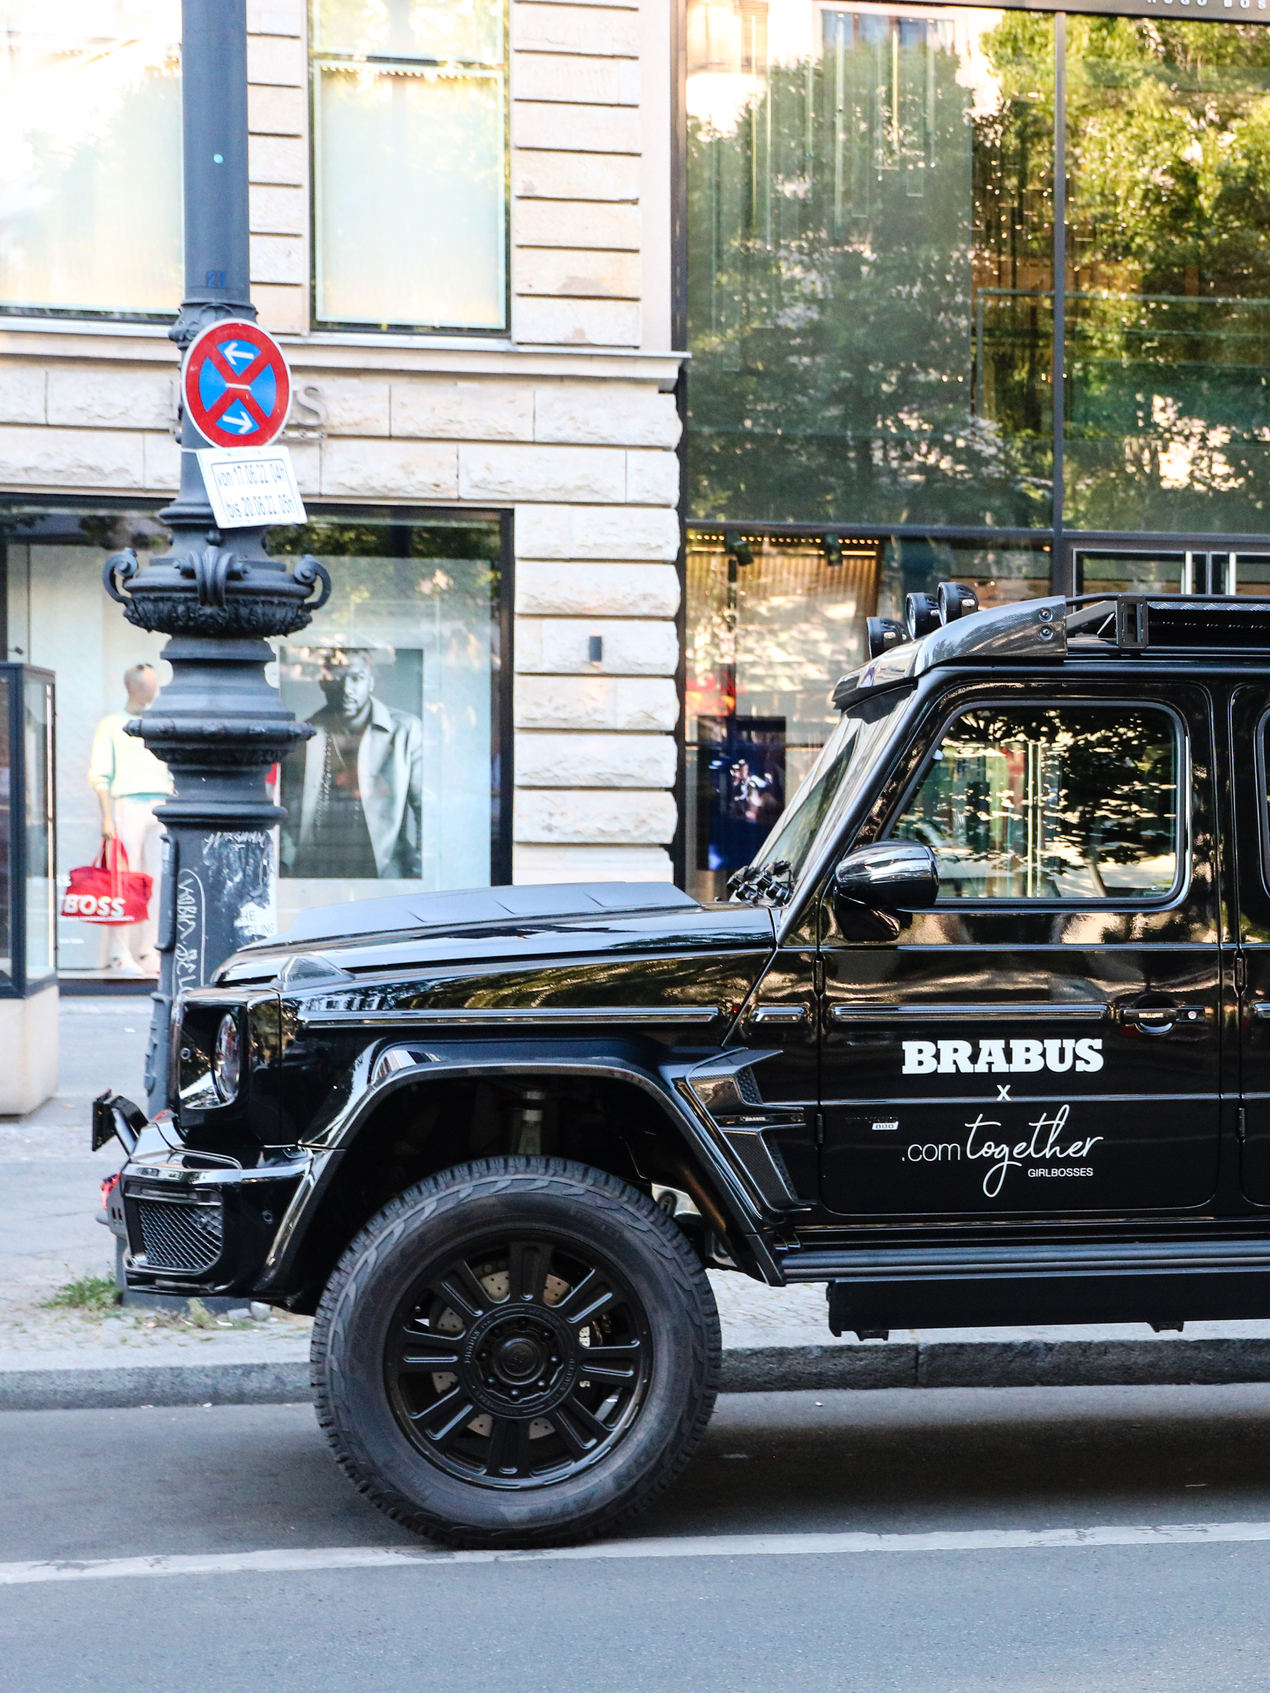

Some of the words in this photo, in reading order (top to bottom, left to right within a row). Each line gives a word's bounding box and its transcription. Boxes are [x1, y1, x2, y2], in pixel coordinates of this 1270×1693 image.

[207, 271, 226, 288] 23
[215, 471, 235, 487] von
[224, 497, 242, 518] bis
[278, 493, 296, 515] 05h
[63, 893, 126, 917] BOSS
[902, 1038, 1104, 1074] BRABUS
[901, 1143, 961, 1162] .com
[964, 1104, 1104, 1198] together
[1027, 1167, 1094, 1178] GIRLBOSSES
